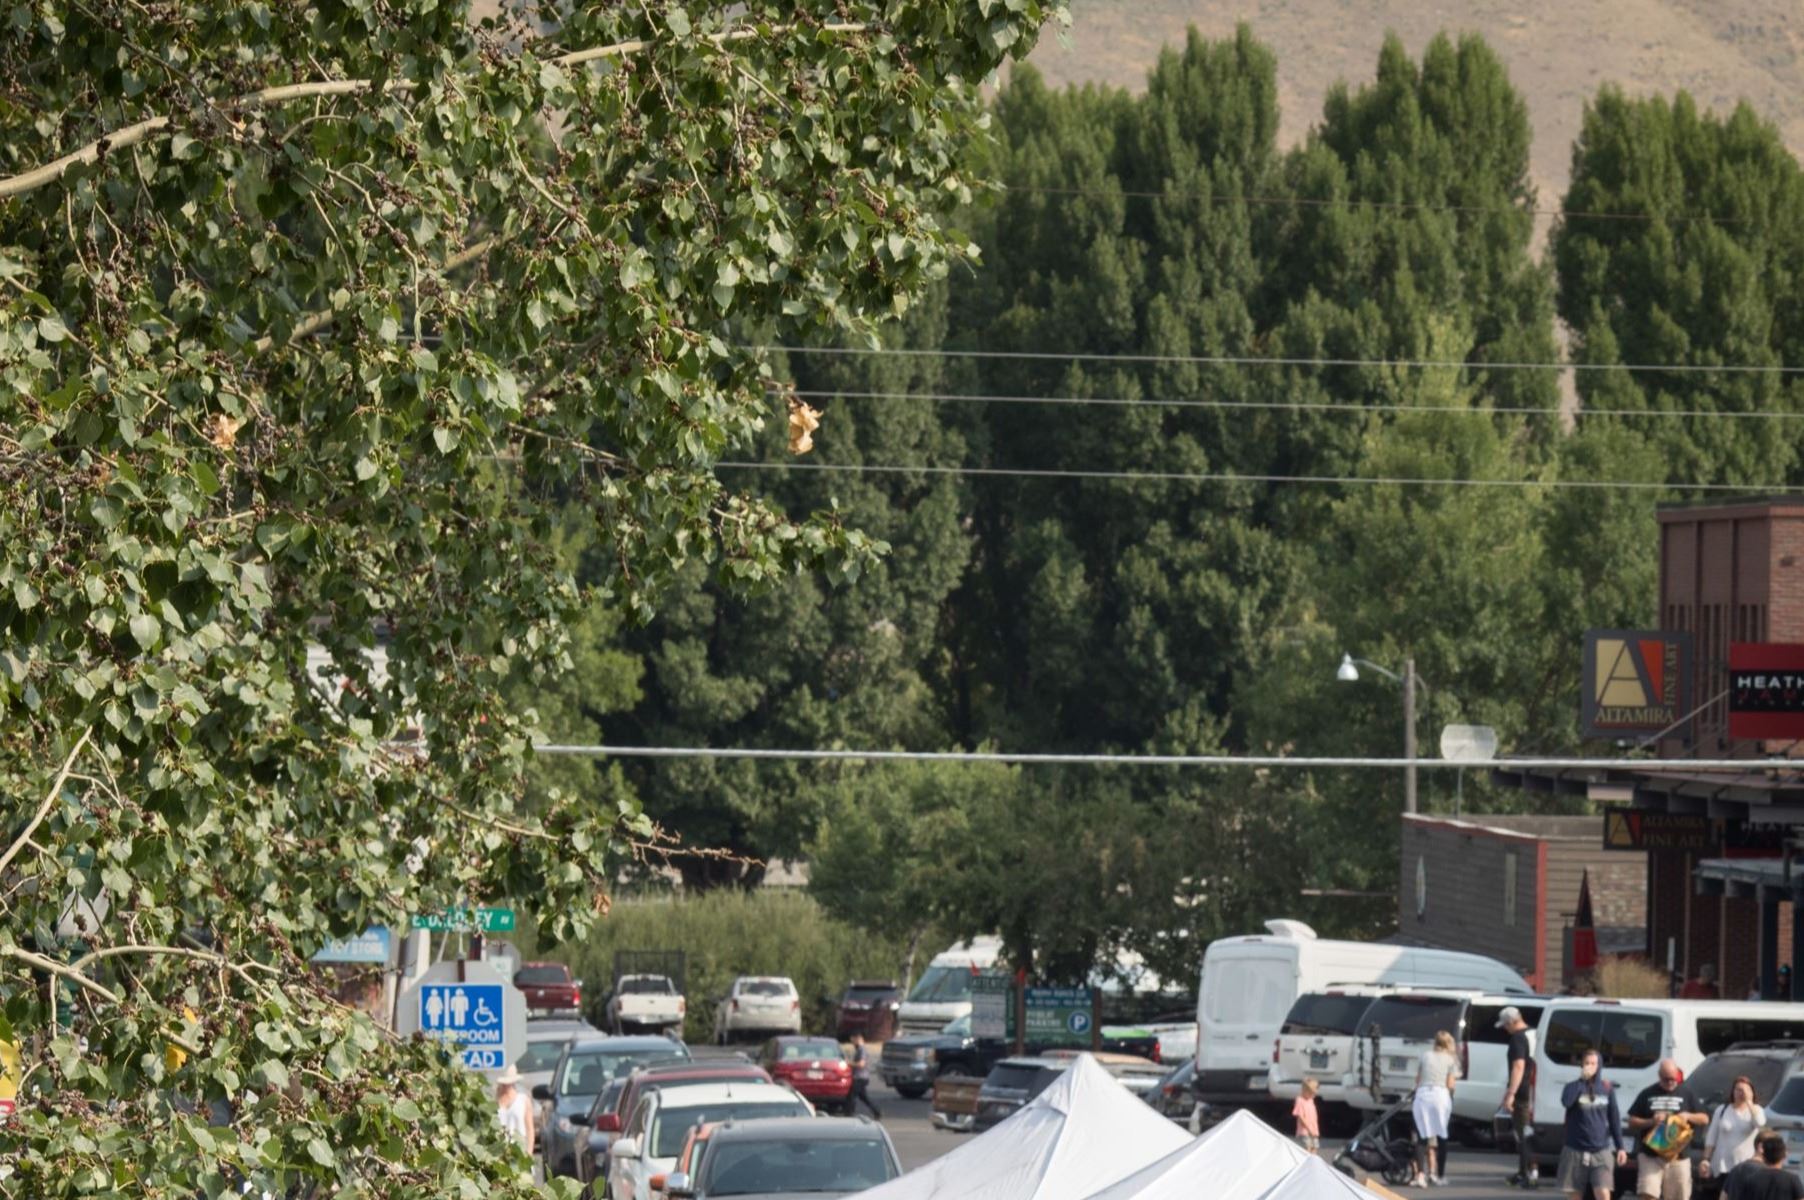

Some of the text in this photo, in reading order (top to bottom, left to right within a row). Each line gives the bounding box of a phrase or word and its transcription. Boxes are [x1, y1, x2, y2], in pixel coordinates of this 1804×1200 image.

[1664, 640, 1677, 670] ART
[1595, 707, 1675, 723] ALTAMIRA
[1073, 1015, 1086, 1030] P
